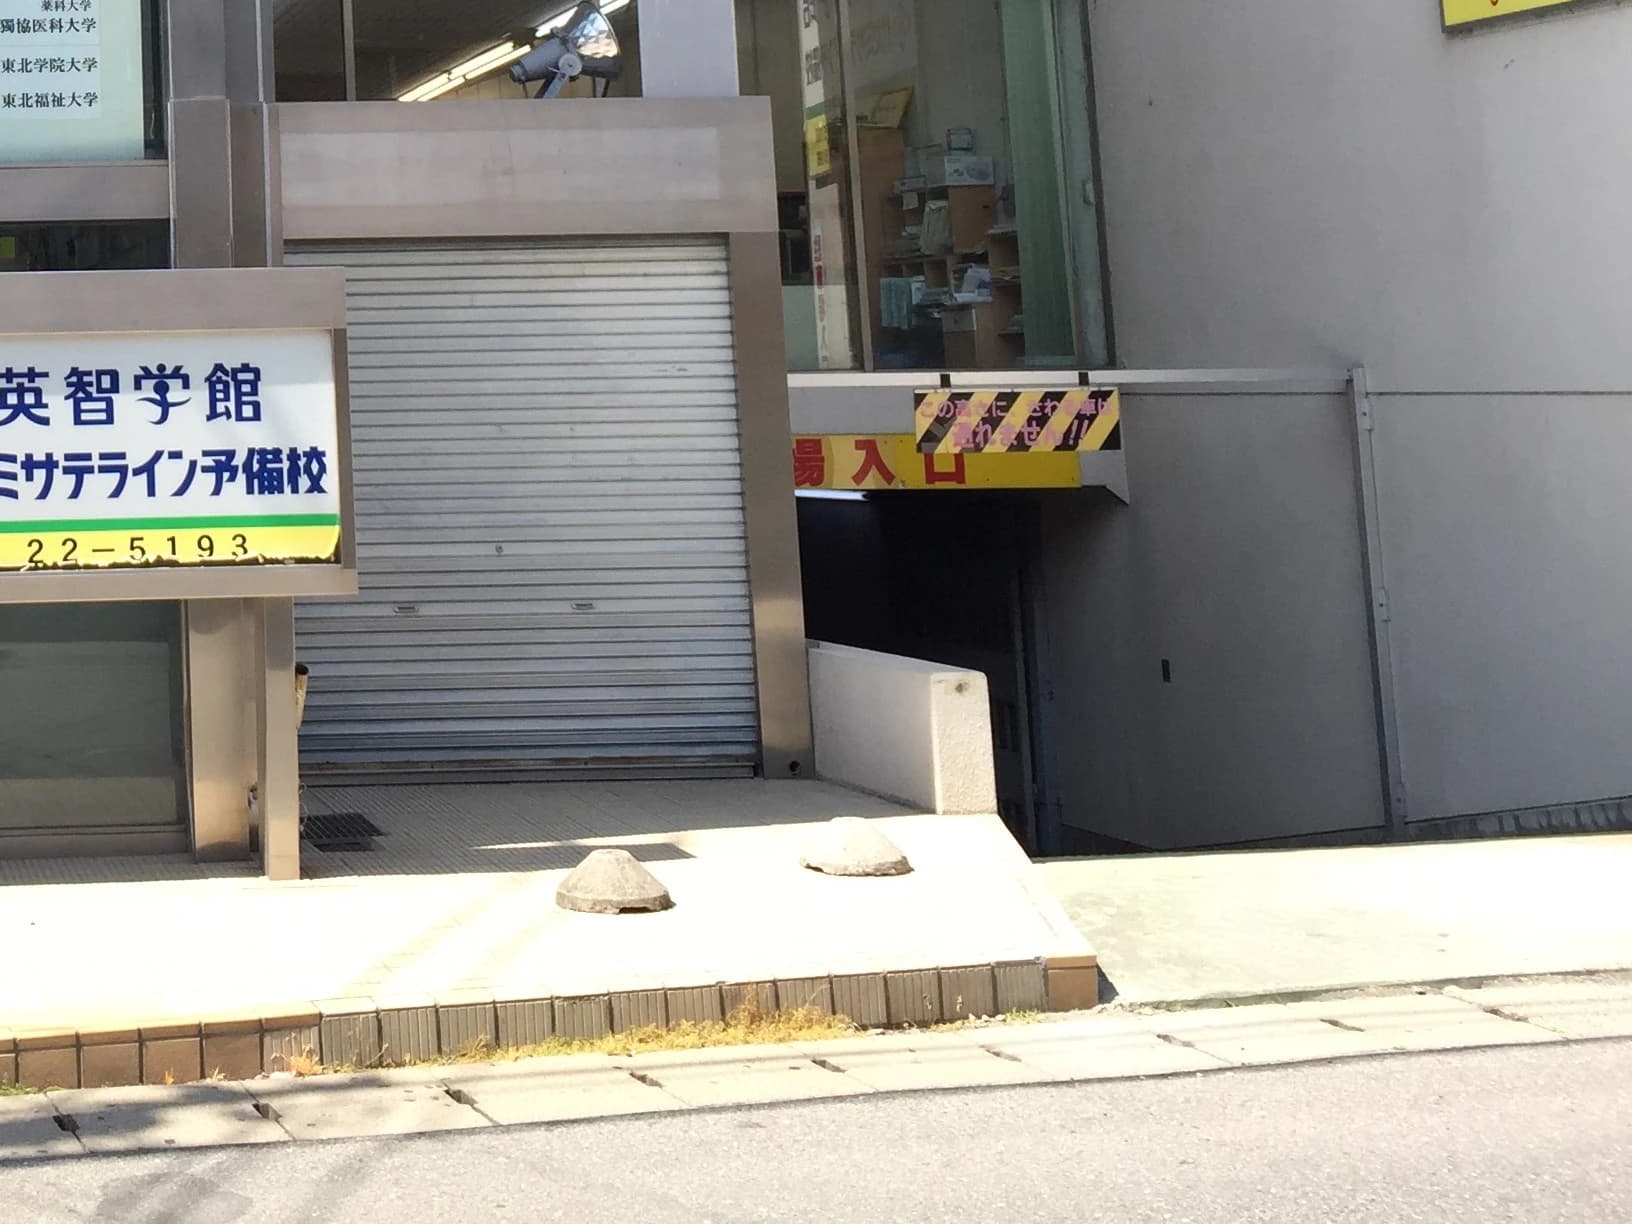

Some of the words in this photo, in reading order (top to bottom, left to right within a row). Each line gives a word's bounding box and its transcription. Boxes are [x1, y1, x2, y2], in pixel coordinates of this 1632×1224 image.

[41, 0, 92, 12] 薬科大学
[0, 17, 96, 33] 獨協医科大学
[1, 57, 98, 73] 東北学院大学
[2, 92, 98, 108] 東北福祉大学
